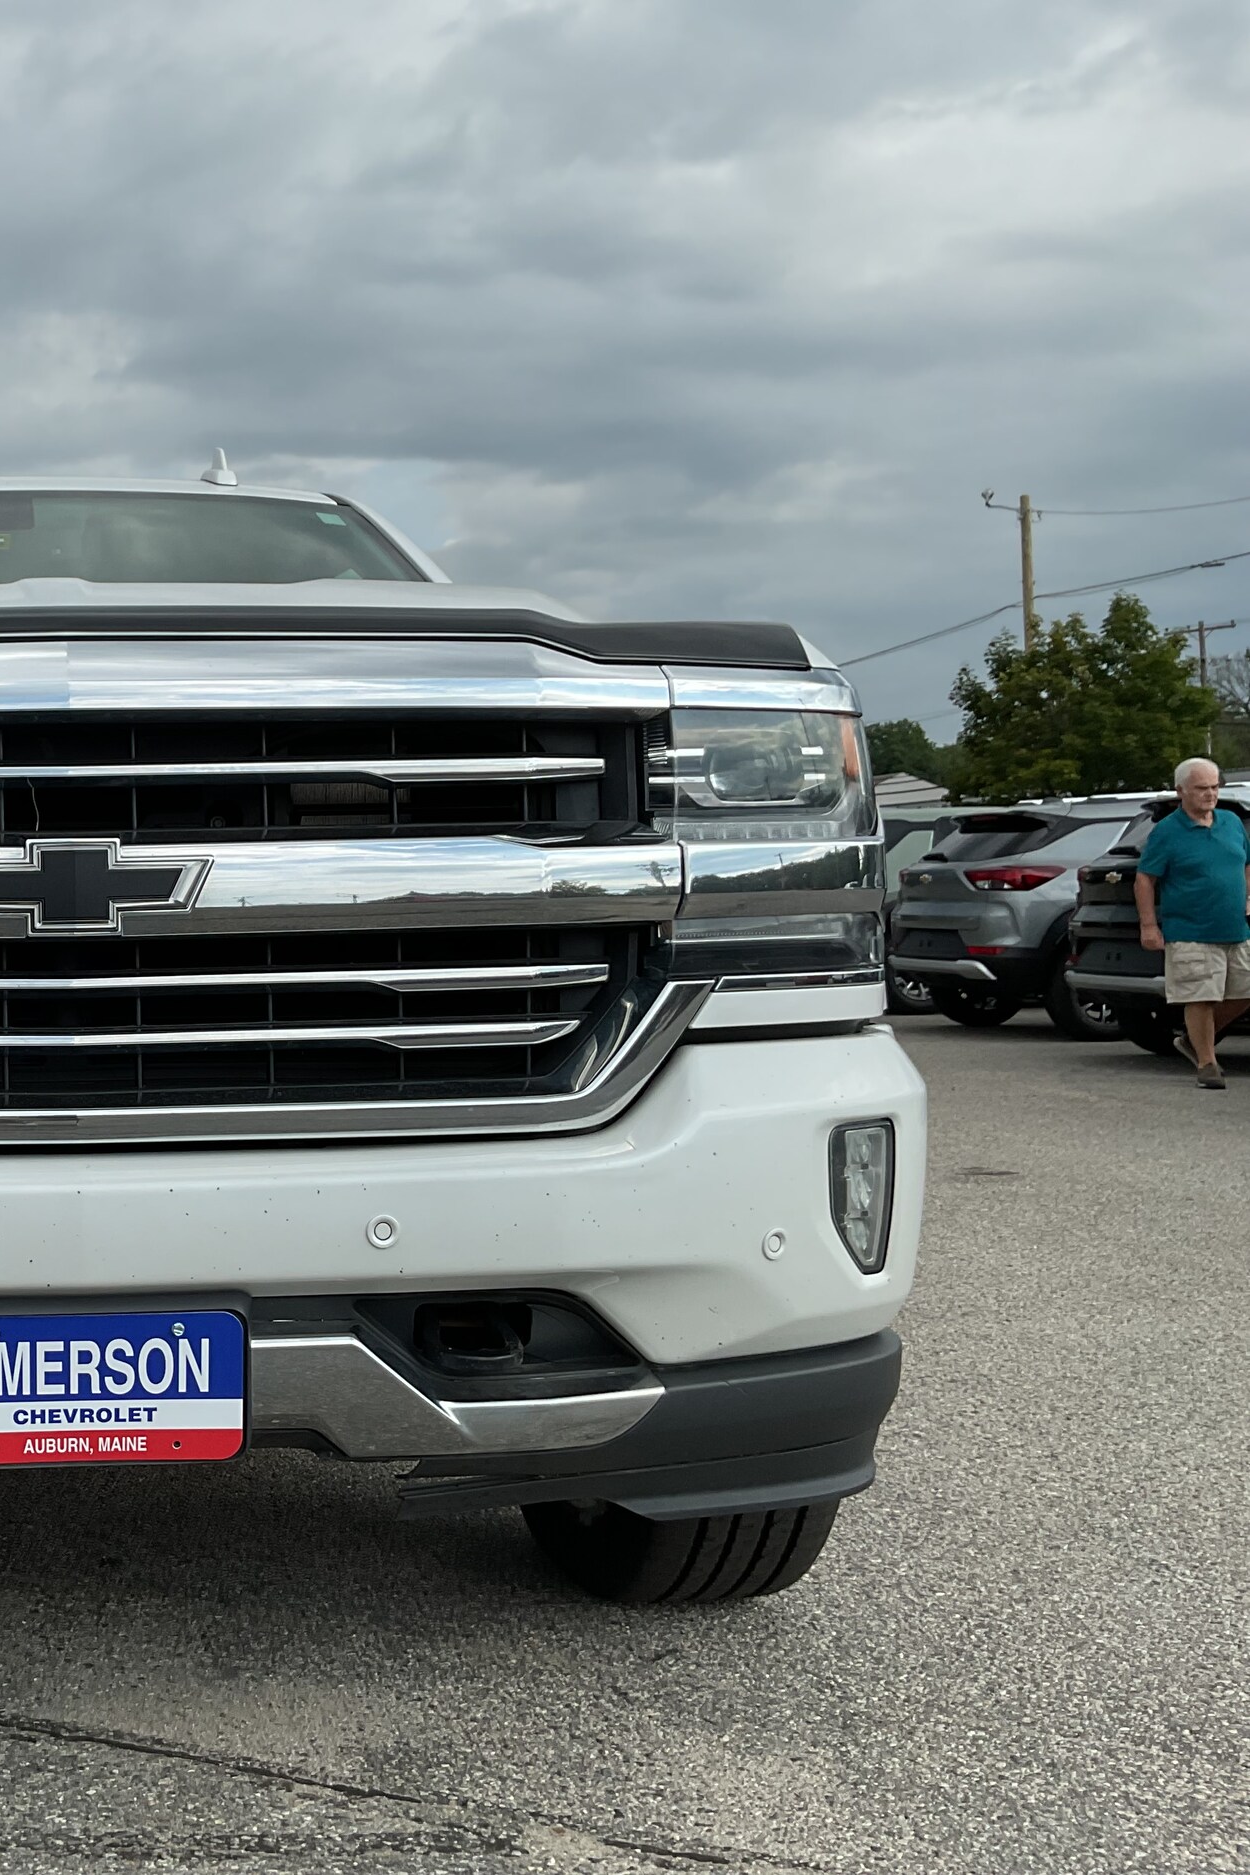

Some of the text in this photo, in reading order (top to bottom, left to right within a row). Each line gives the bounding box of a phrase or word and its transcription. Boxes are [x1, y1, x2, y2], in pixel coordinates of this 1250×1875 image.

[12, 1407, 158, 1425] CHEVROLET
[23, 1436, 148, 1455] AUBURN, MAINE
